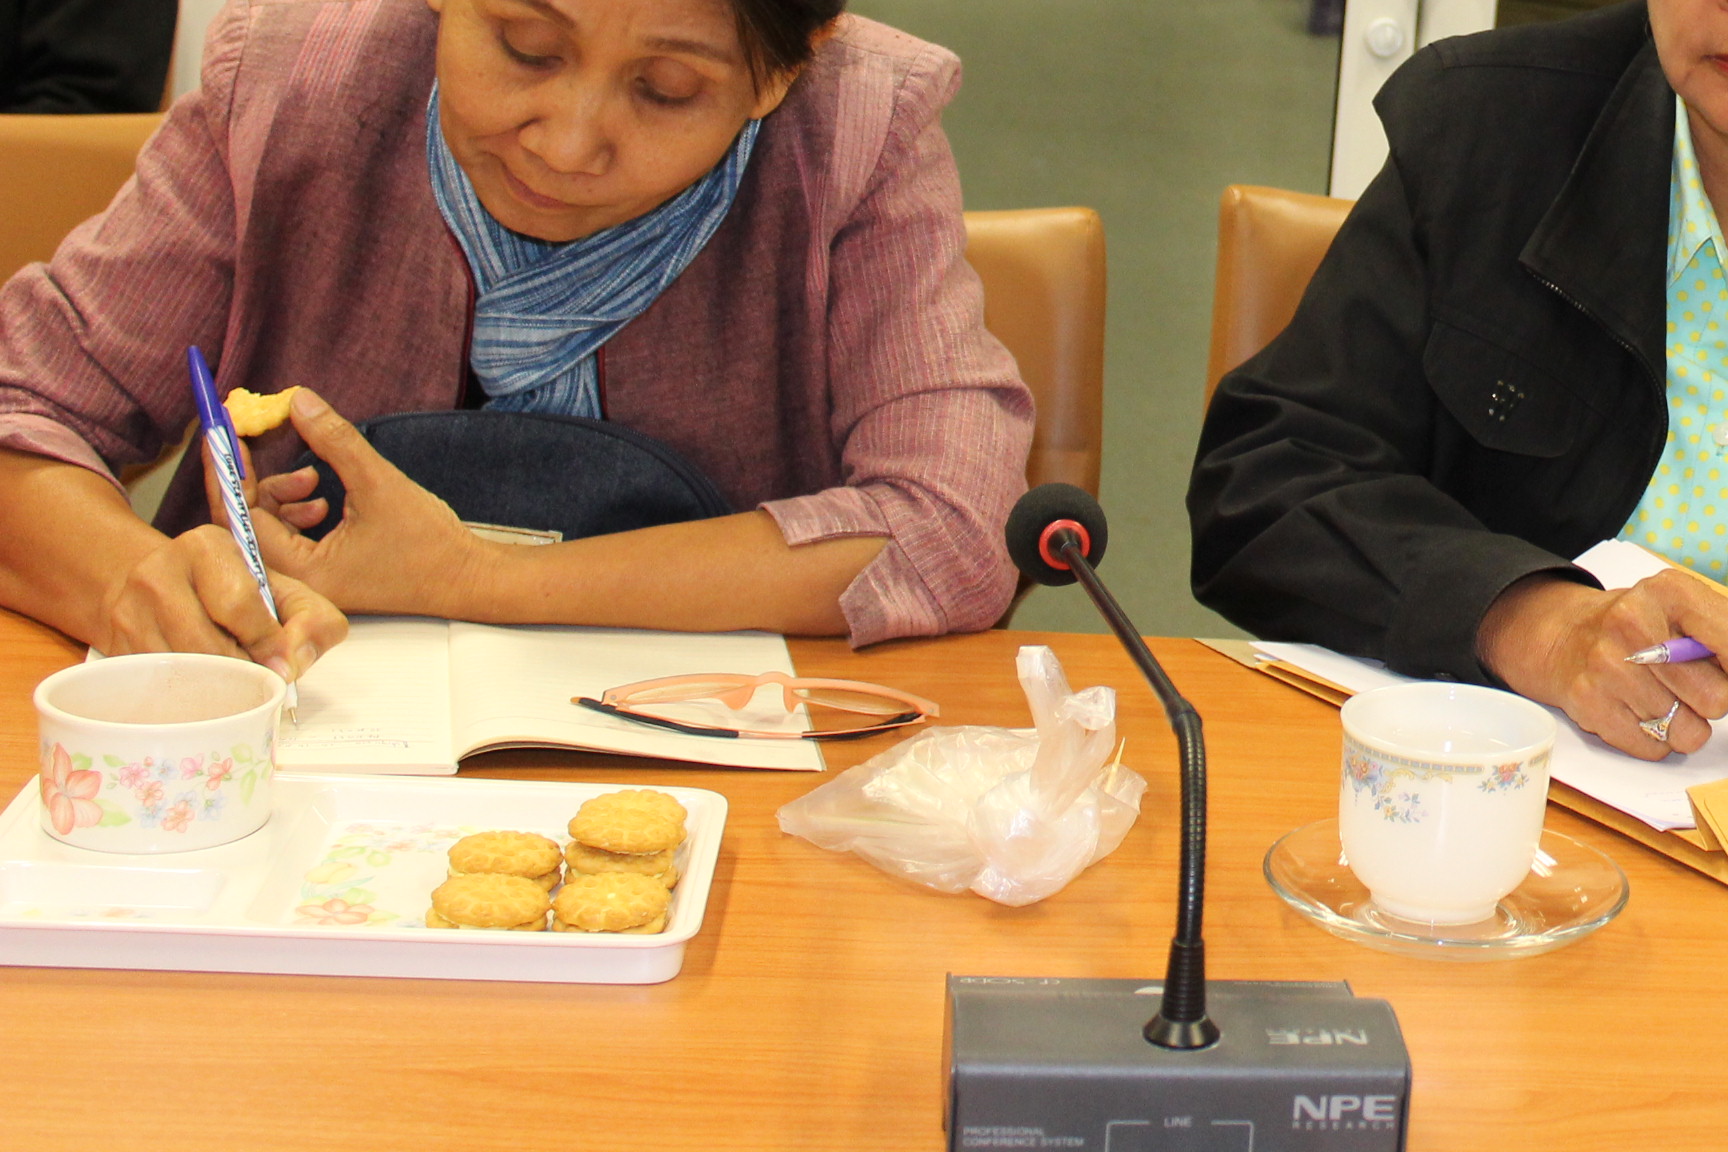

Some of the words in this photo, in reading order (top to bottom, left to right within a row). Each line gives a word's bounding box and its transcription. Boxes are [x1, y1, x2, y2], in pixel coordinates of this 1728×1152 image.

[1266, 1031, 1368, 1045] NPE
[1293, 1094, 1397, 1121] NPE
[1164, 1116, 1192, 1128] LINE
[962, 1126, 1044, 1136] PROFESSIONAL
[962, 1137, 1036, 1147] CONFERENCE
[1041, 1137, 1084, 1147] SYSTEM
